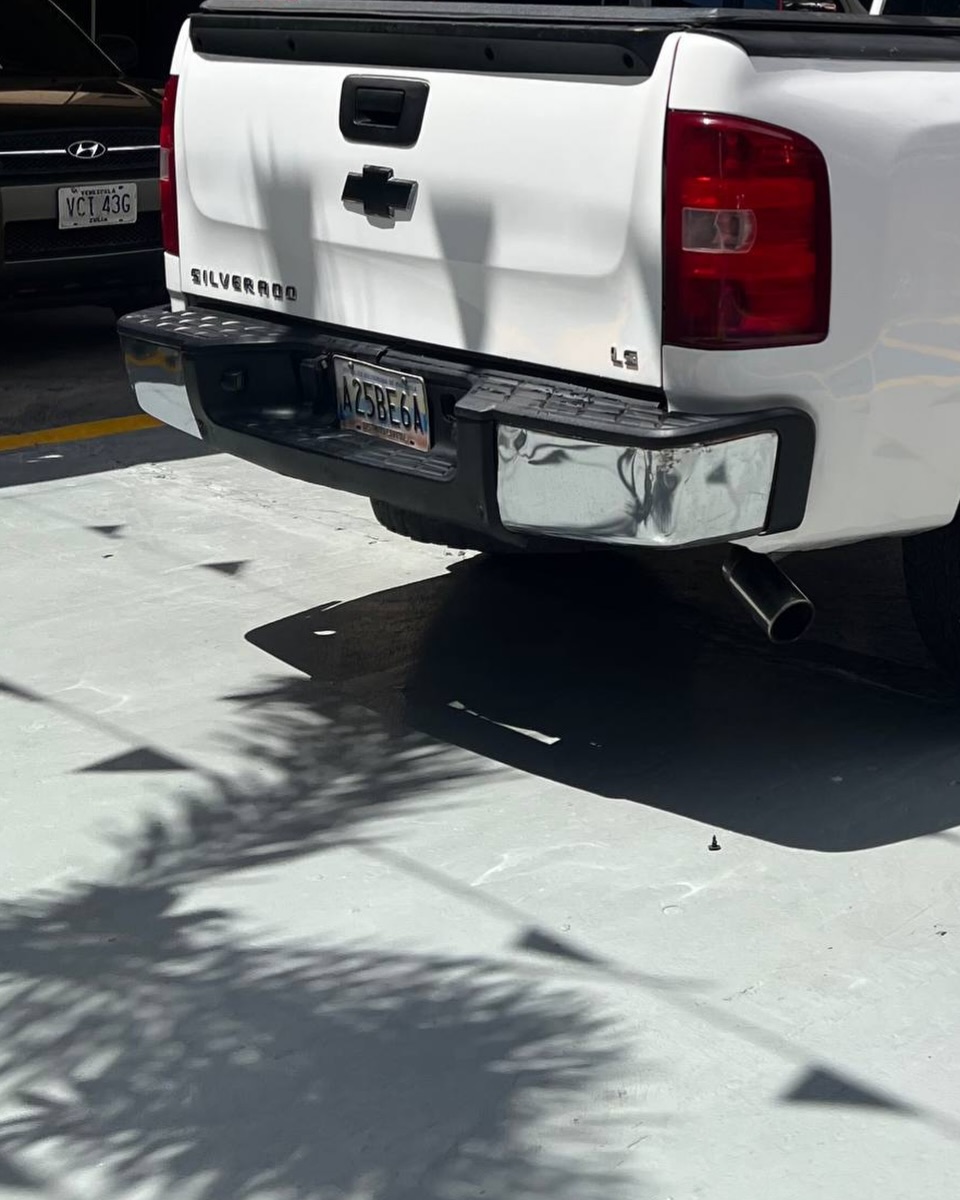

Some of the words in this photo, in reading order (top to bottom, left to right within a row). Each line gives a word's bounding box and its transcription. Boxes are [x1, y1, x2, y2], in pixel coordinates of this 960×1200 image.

[66, 196, 94, 217] VCT
[102, 193, 131, 214] 43G
[191, 268, 297, 301] SILVERADO
[611, 347, 639, 371] LS
[343, 375, 424, 435] A25BE6A
